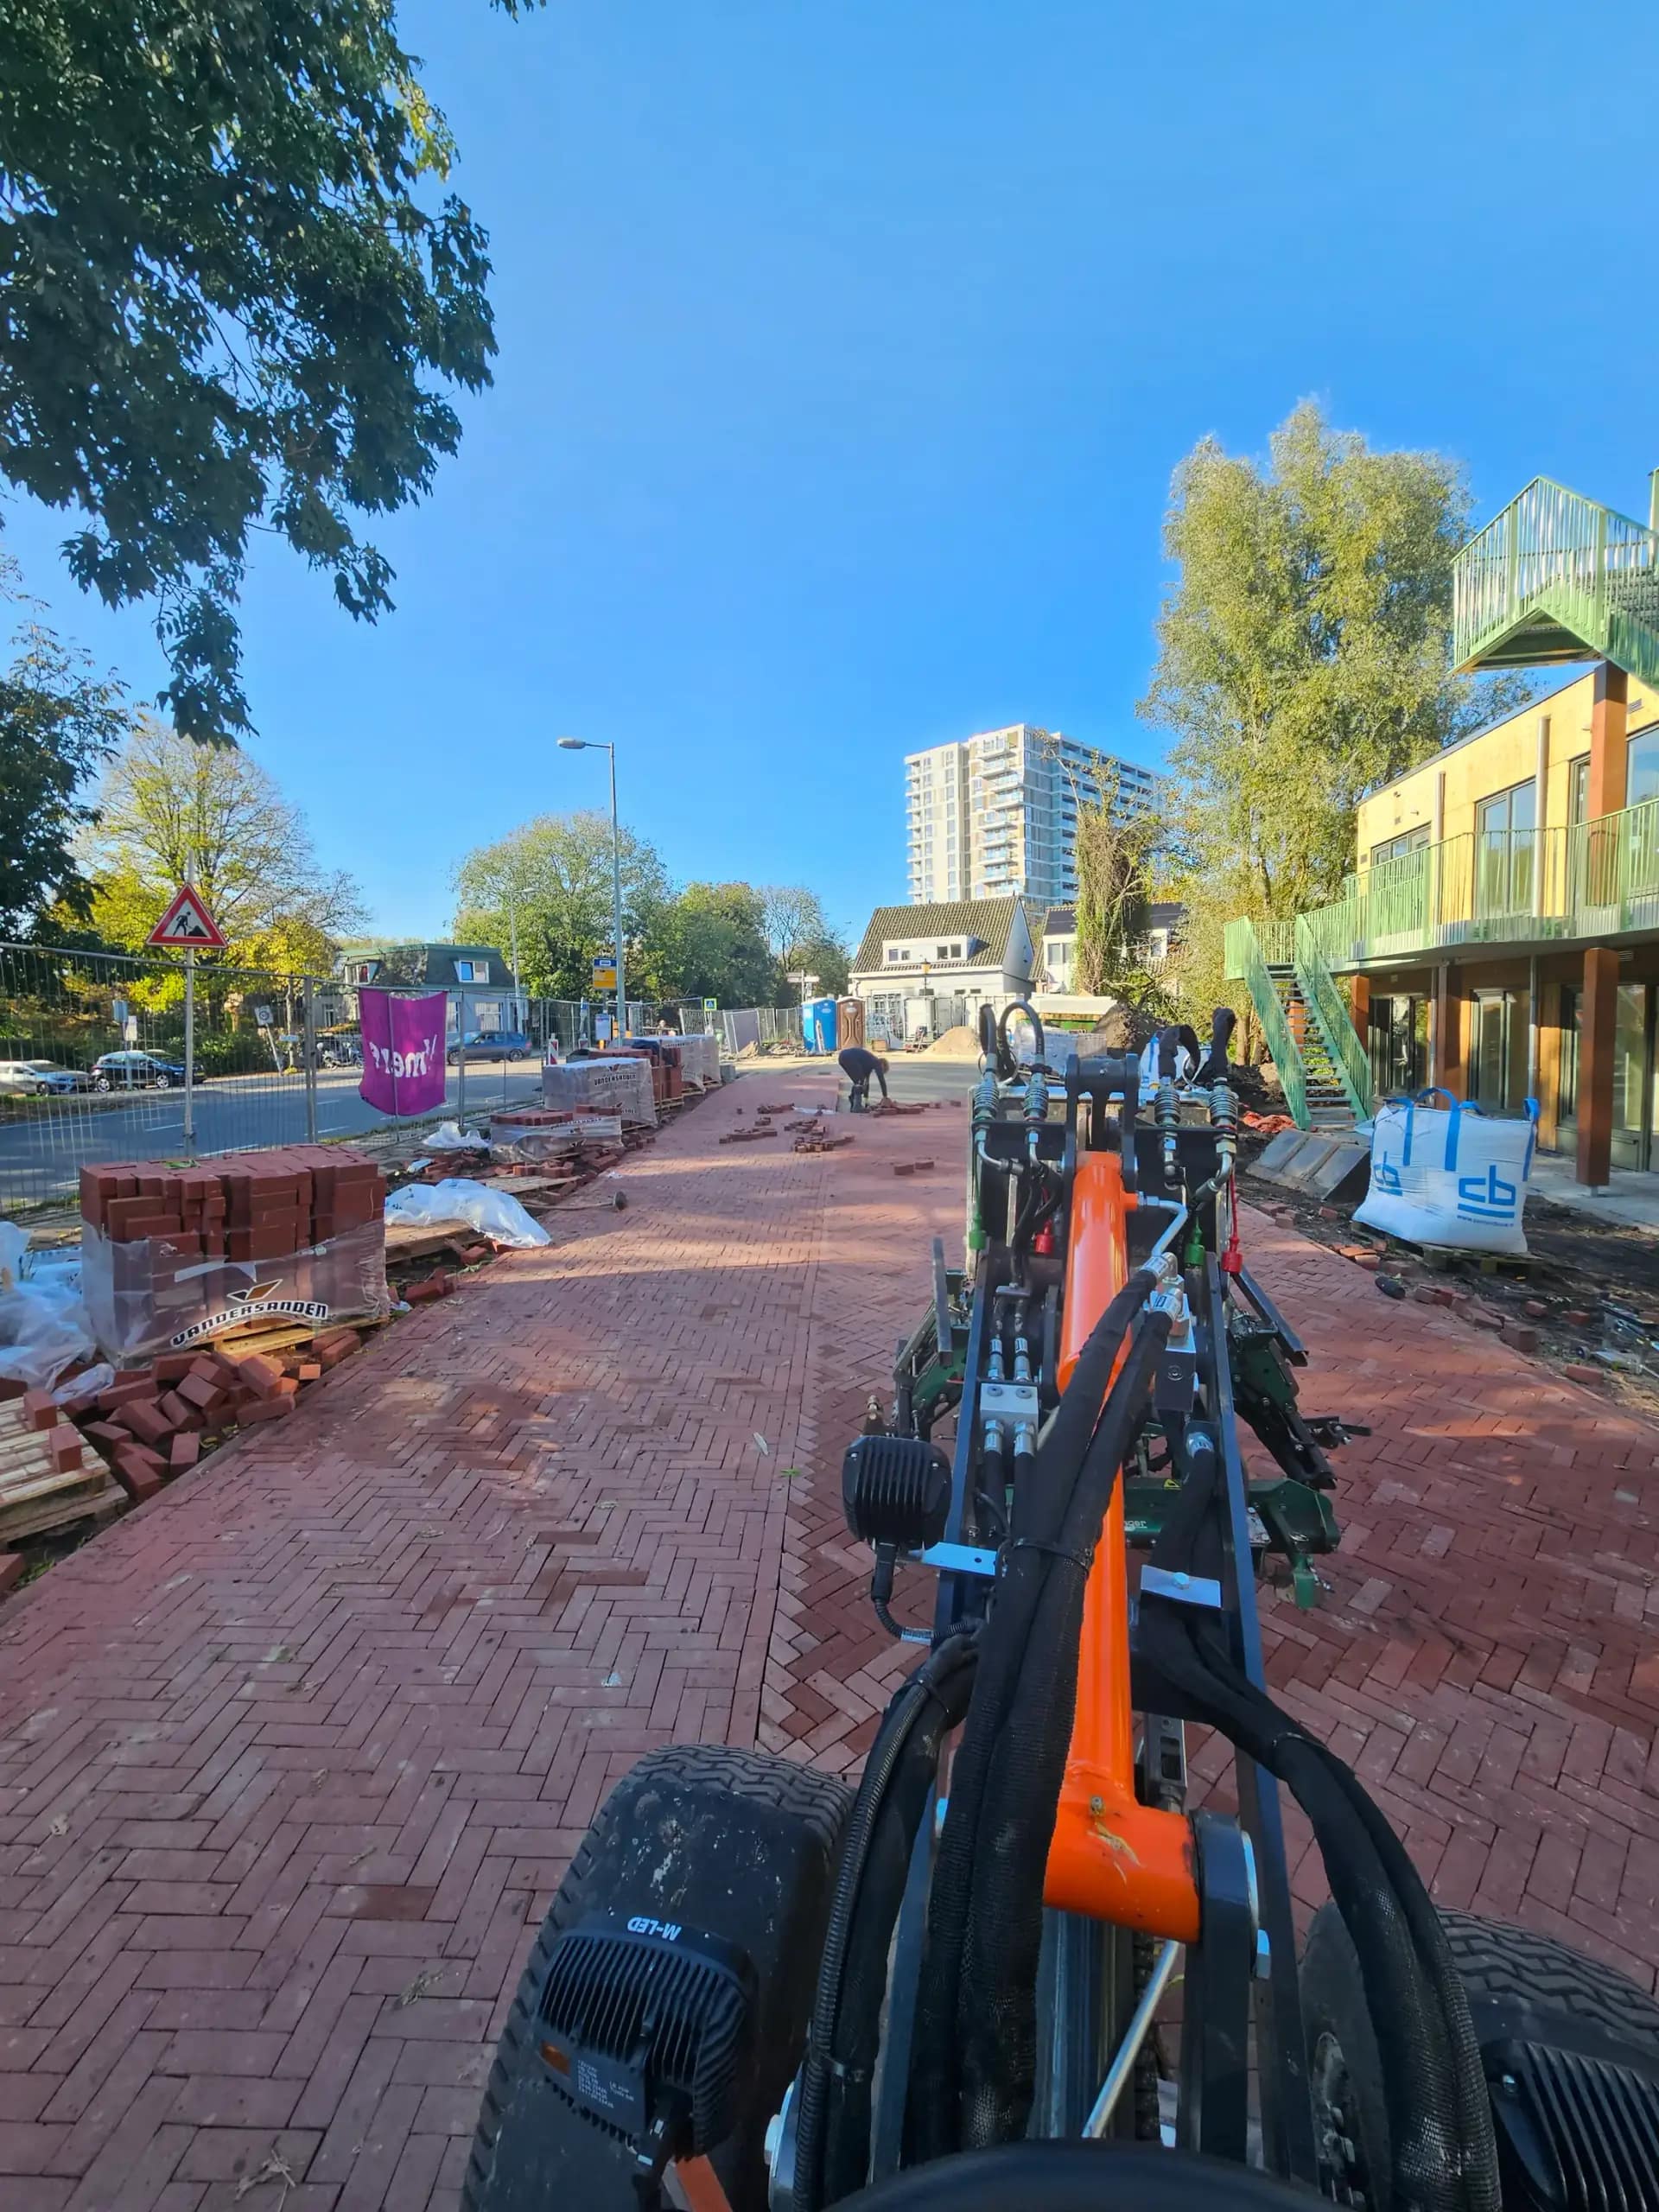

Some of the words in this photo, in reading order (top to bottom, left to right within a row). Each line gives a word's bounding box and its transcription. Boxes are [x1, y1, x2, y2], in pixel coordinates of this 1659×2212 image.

[1458, 1165, 1516, 1206] cb
[172, 1301, 327, 1345] VANDERSANDEN
[627, 1916, 682, 1941] M-LED
